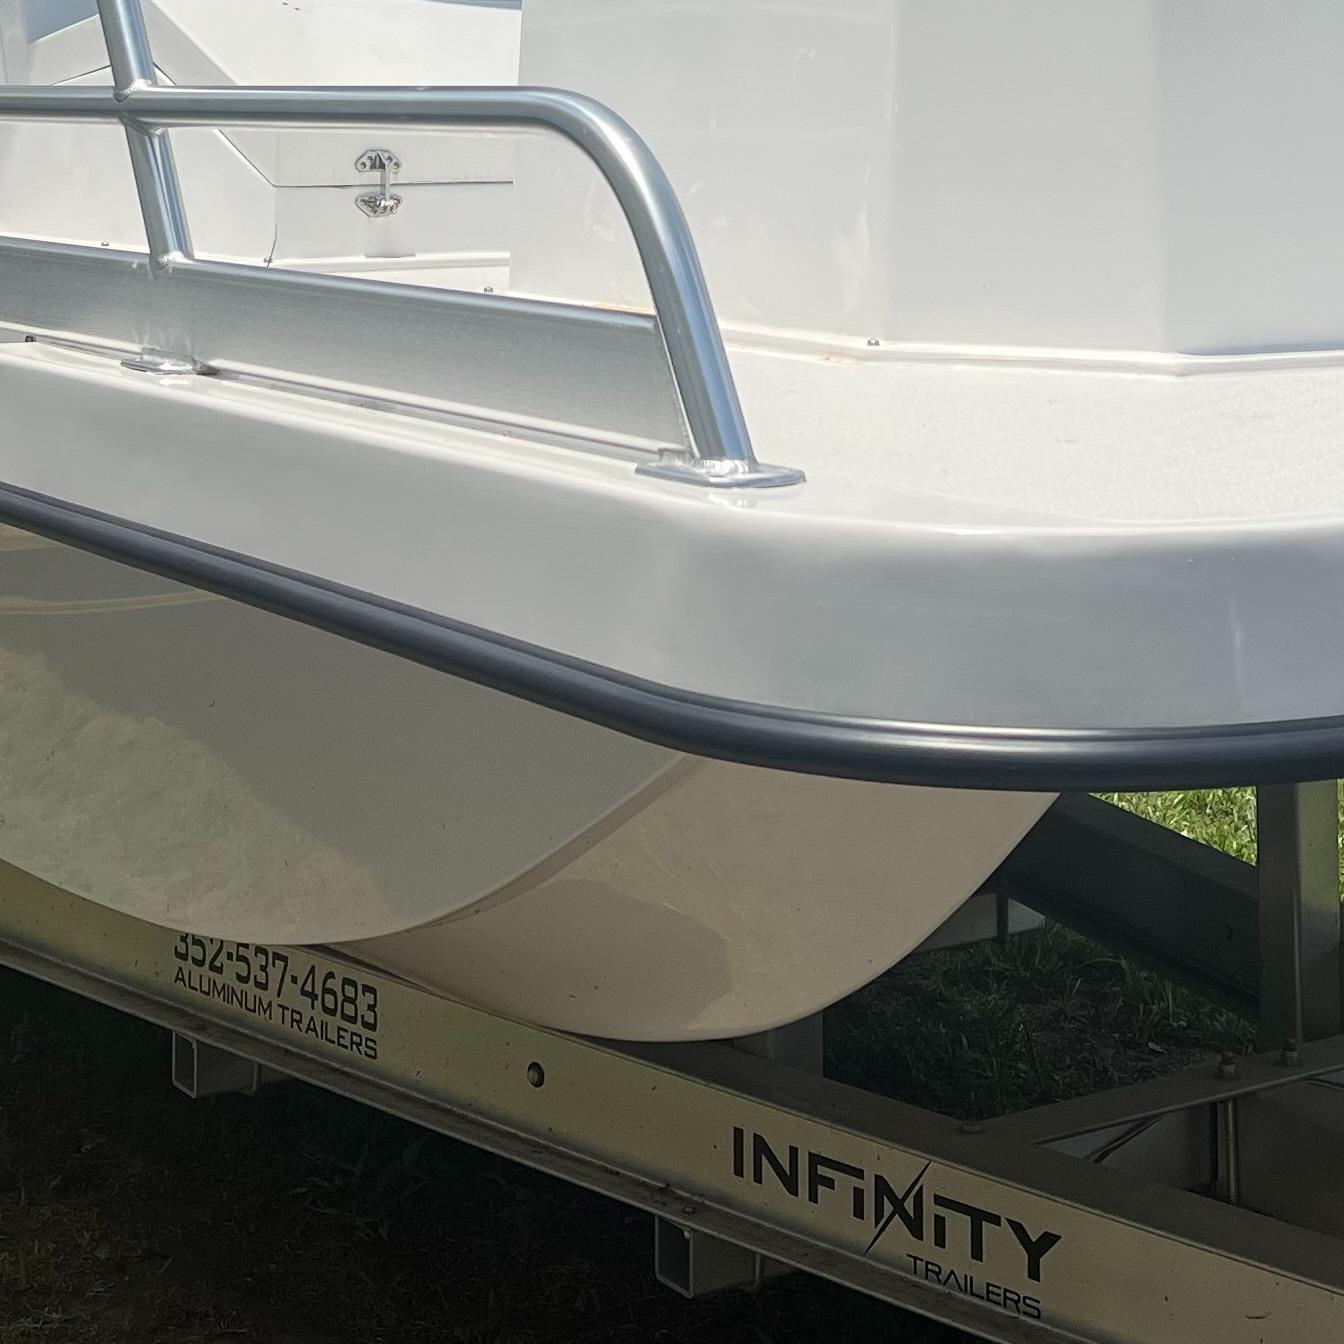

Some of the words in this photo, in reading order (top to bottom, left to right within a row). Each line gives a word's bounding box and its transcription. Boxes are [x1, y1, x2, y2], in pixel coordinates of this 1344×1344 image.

[173, 966, 273, 1020] ALUMINUM
[277, 1003, 378, 1060] TRAILERS
[174, 932, 378, 1032] 352-537-4683
[906, 1253, 1042, 1320] TRAILERS
